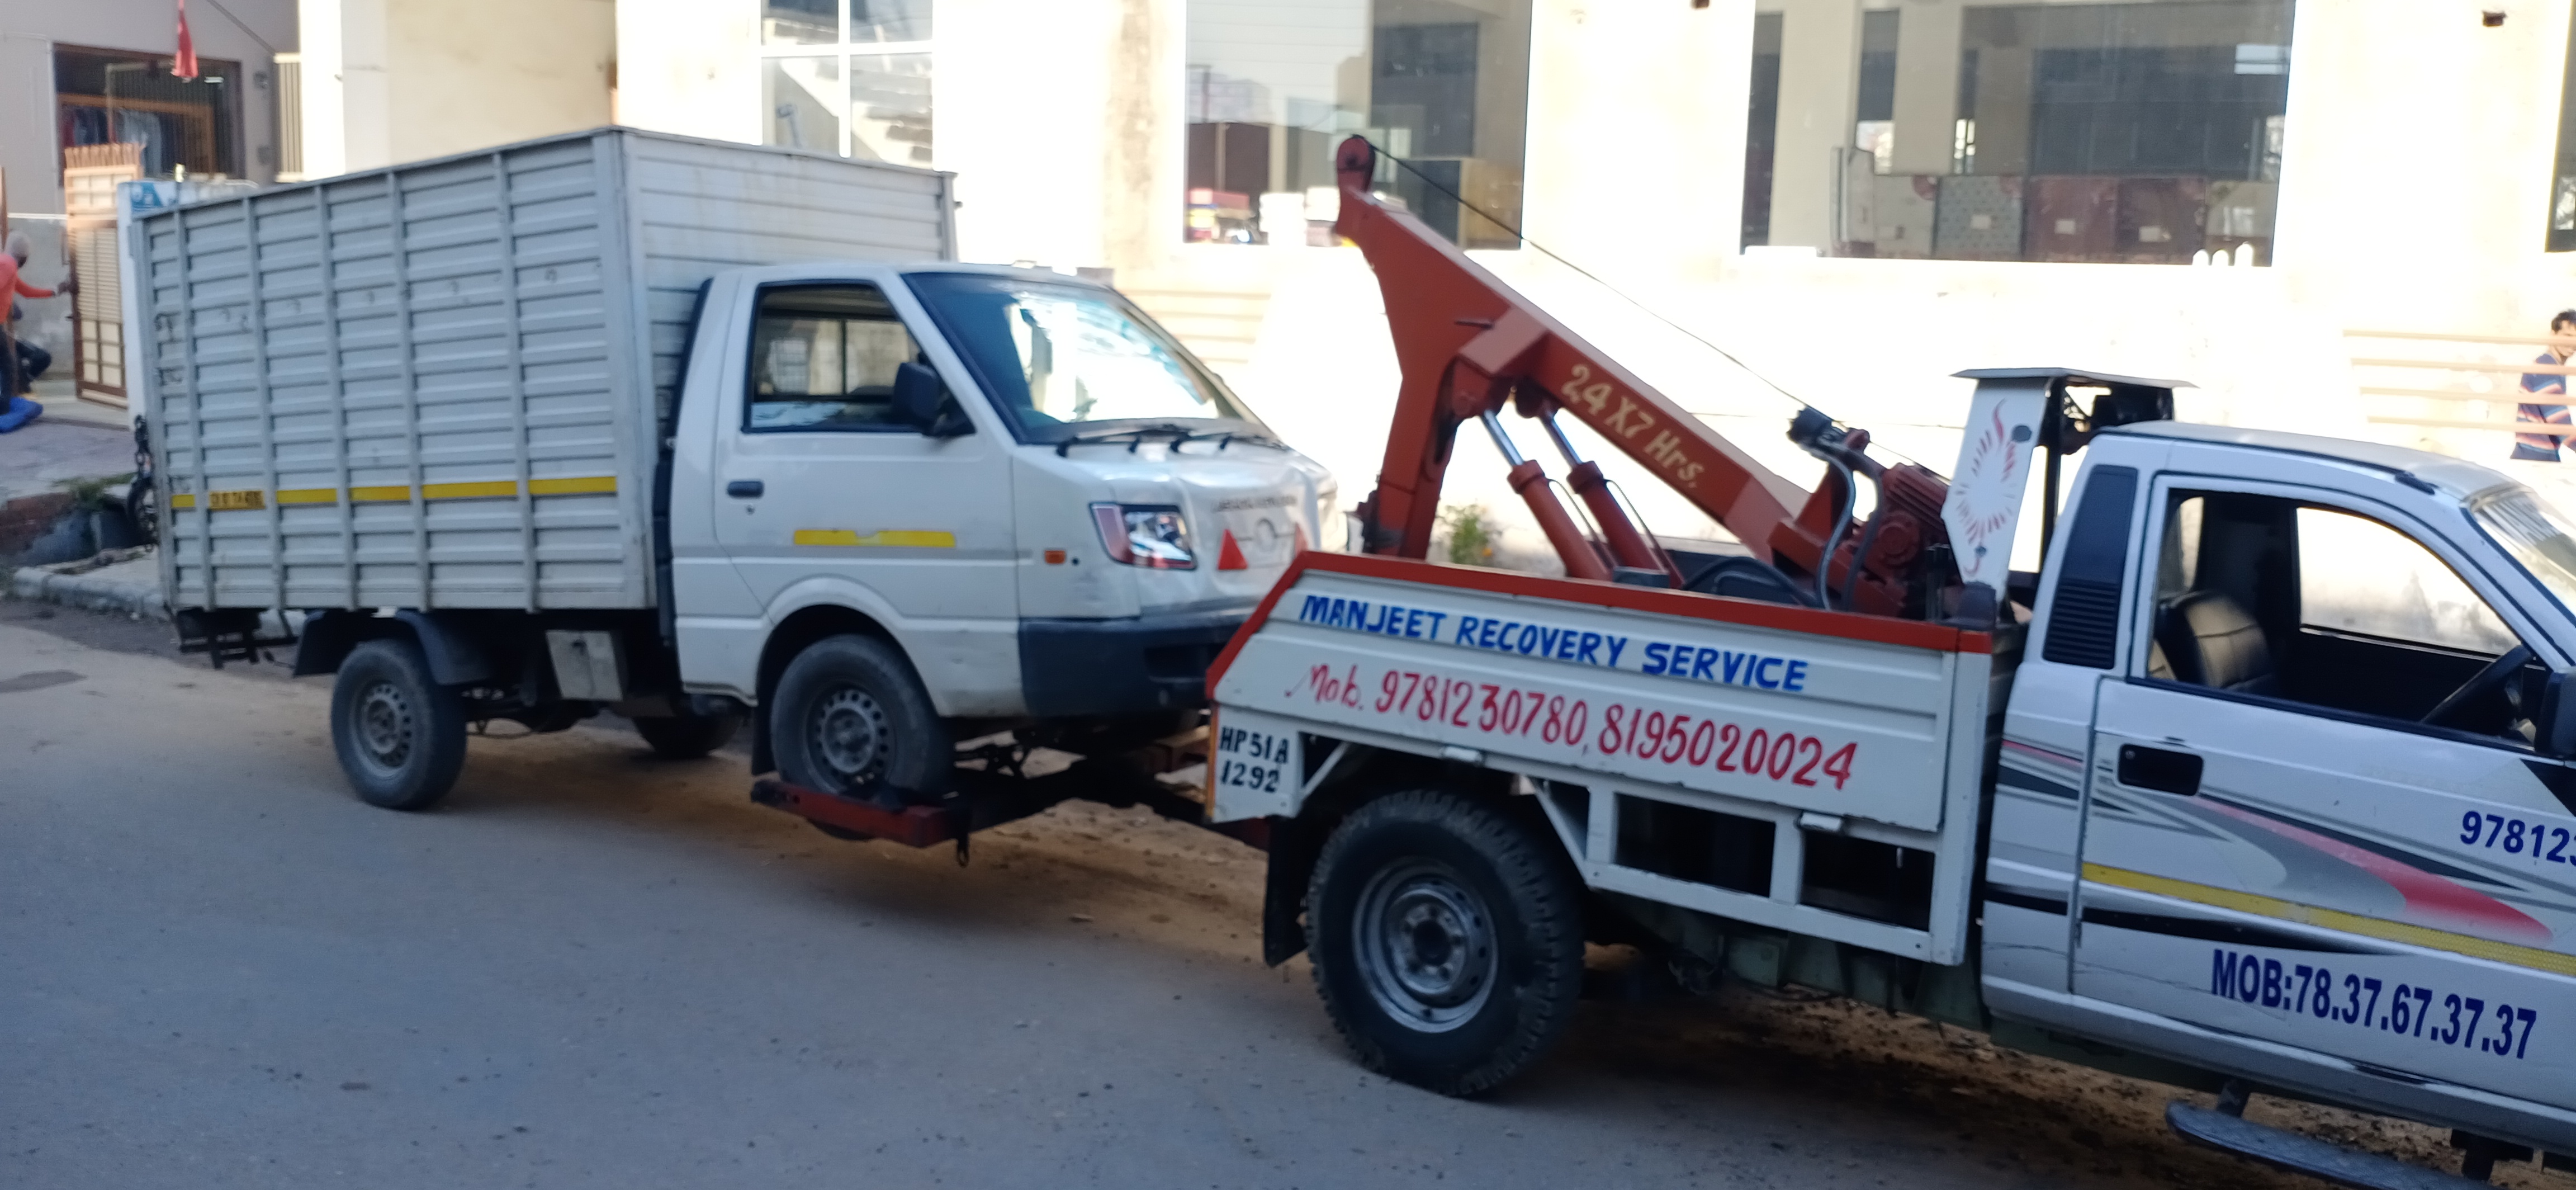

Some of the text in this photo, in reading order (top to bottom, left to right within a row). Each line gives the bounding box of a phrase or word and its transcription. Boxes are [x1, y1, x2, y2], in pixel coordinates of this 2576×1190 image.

[1644, 428, 1705, 488] Hrs.
[1299, 594, 1808, 692] MANJEET RECOVERY SERVICE
[1219, 726, 1290, 764] HP51A
[1285, 663, 1364, 712] Mob.
[1598, 704, 1858, 790] 8195020024
[1220, 759, 1280, 793] 1292
[2211, 950, 2538, 1059] MOB:78.37.67.37.37
